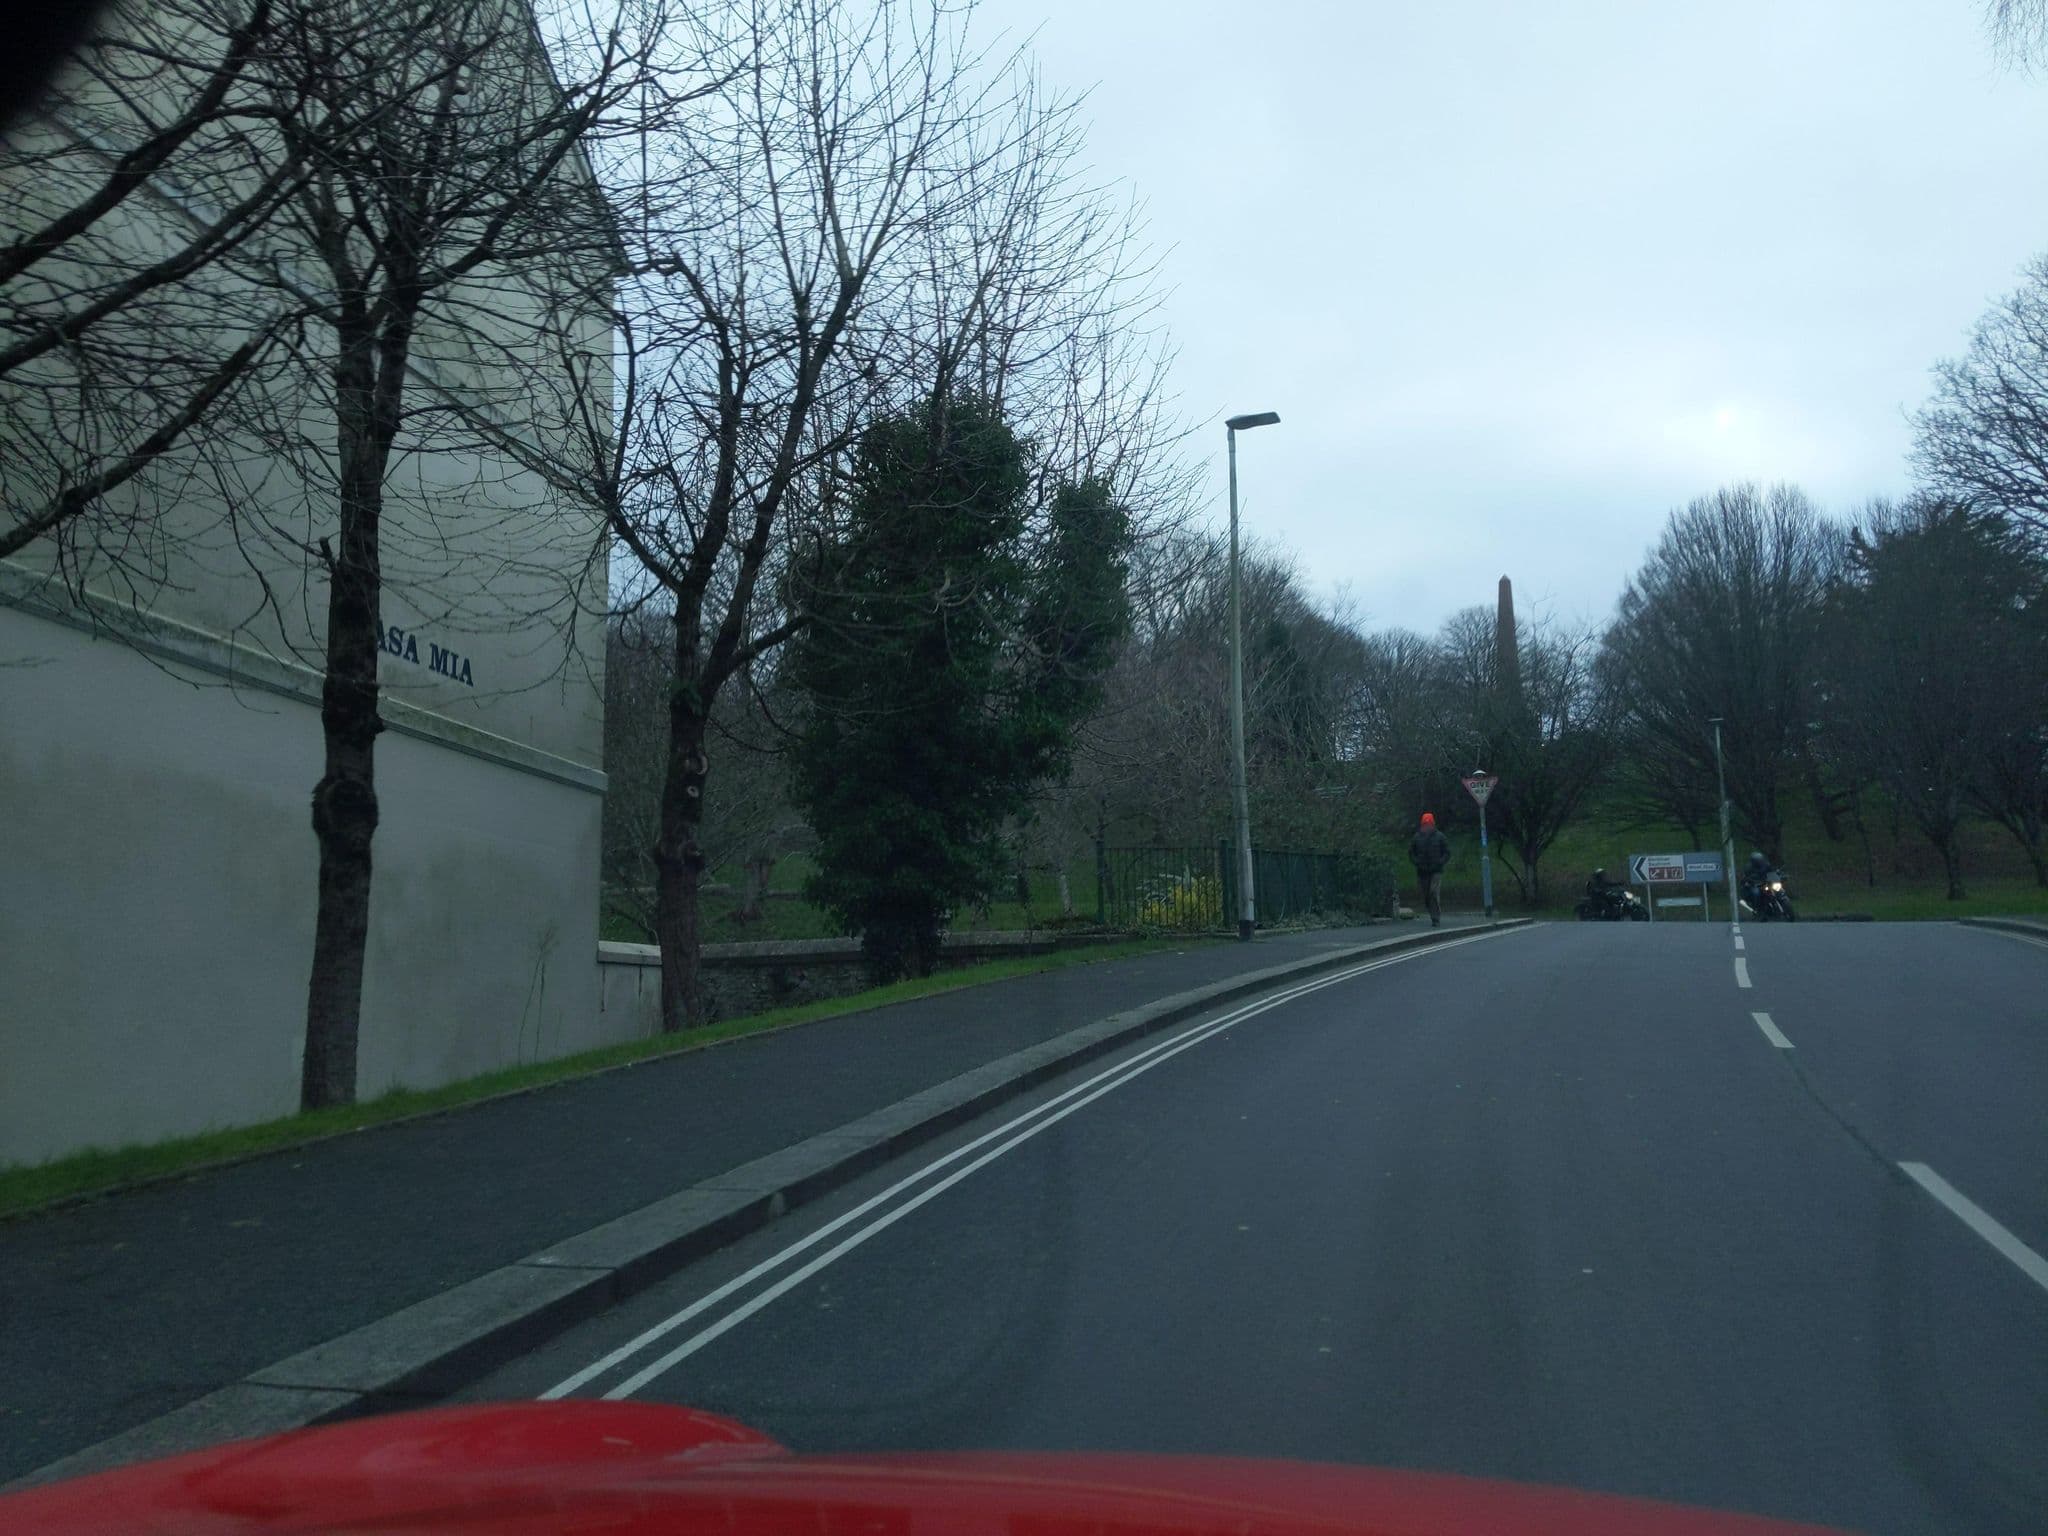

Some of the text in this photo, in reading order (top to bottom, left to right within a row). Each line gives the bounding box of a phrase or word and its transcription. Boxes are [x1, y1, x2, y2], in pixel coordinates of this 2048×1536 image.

[377, 620, 474, 686] ASA MIA
[1470, 780, 1490, 788] GIVE
